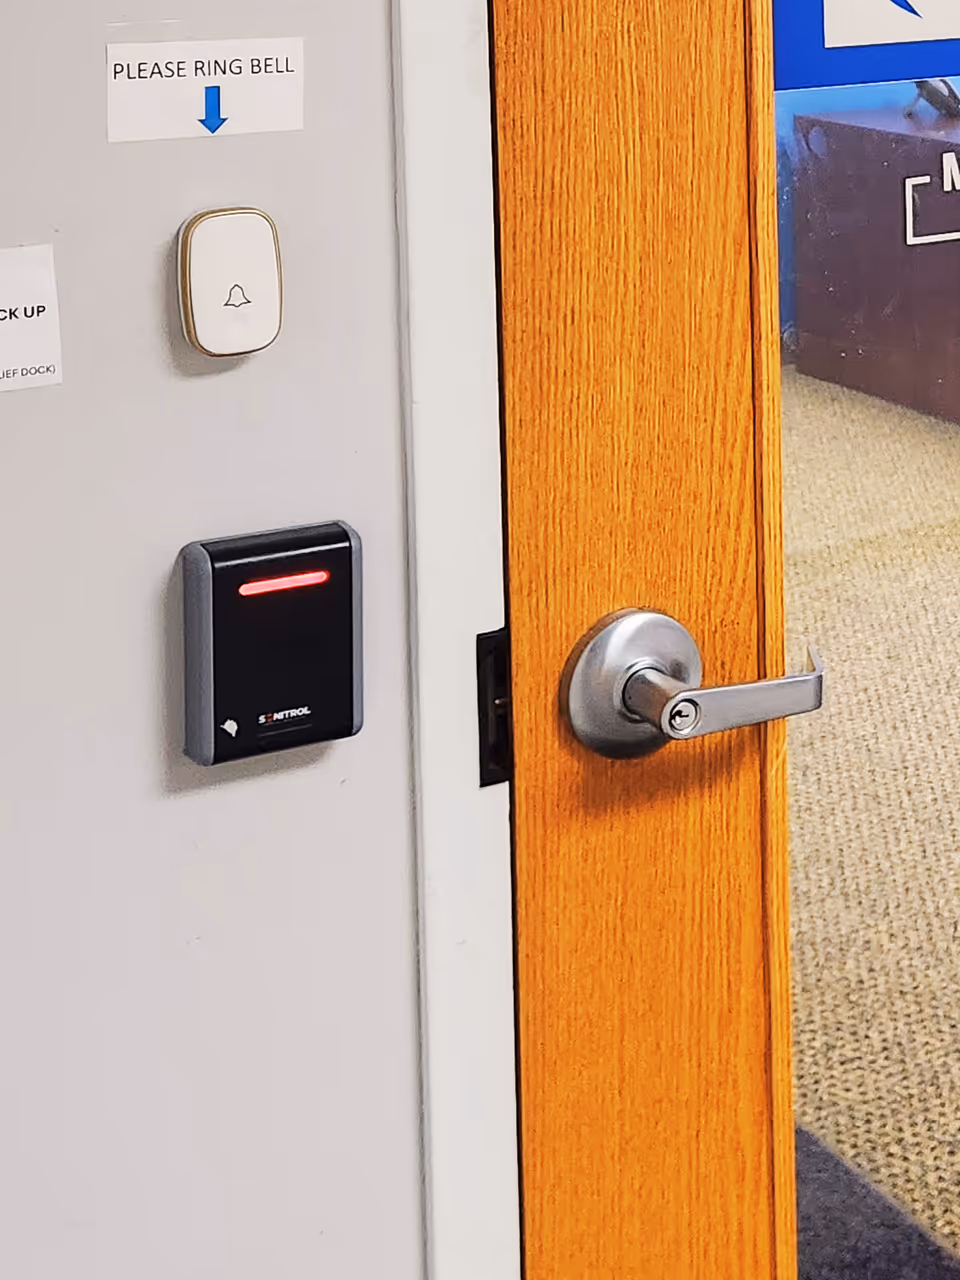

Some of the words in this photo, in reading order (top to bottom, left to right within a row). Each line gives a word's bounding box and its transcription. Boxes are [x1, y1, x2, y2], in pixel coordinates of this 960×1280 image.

[113, 61, 187, 80] PLEASE
[194, 58, 243, 77] RING
[250, 56, 296, 75] BELL
[23, 305, 47, 319] UP
[20, 363, 56, 377] DOCK)
